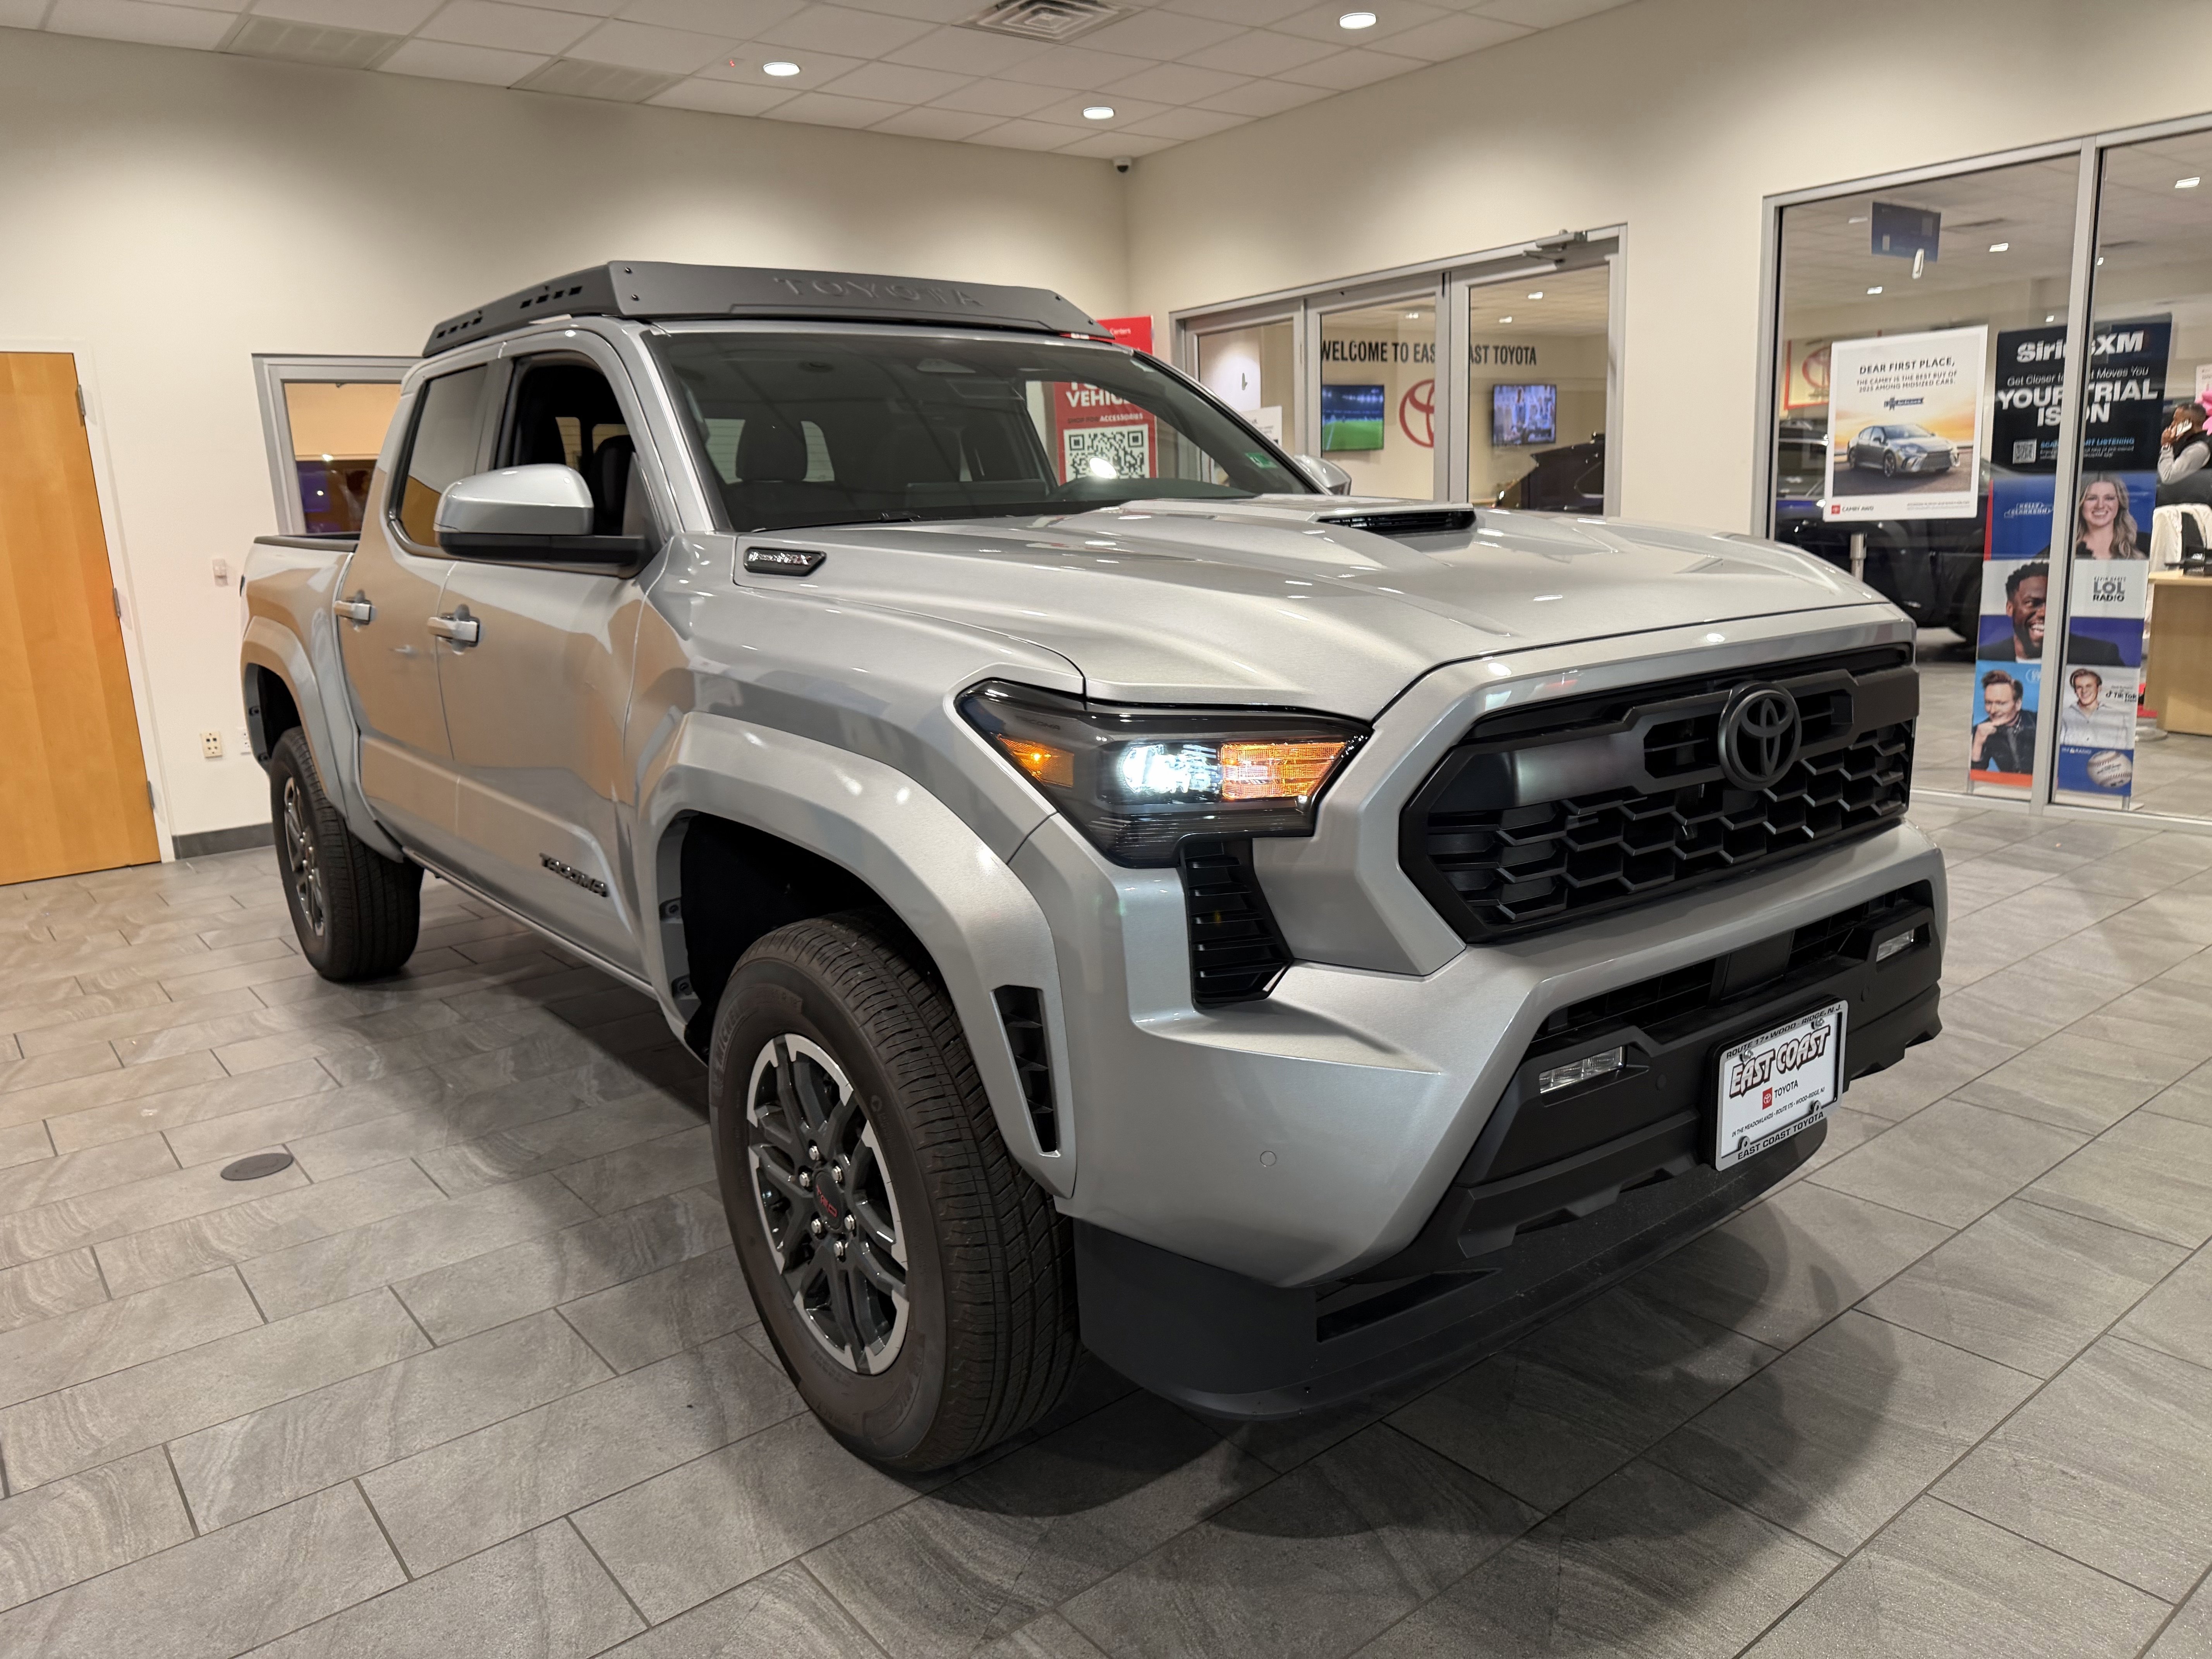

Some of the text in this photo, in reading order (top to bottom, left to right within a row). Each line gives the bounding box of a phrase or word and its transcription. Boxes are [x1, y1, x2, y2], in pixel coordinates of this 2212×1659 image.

[775, 277, 984, 306] TOYOTA
[1322, 340, 1388, 362] WELCOME
[1392, 342, 1408, 363] TO
[1414, 343, 1435, 363] EAS
[1492, 345, 1537, 366] TOYOTA
[2016, 330, 2144, 363] SiriXM
[1860, 356, 1955, 375] DEAR FIRST PLACE,
[1066, 389, 1130, 407] VEHIC
[1099, 412, 1143, 422] ACCESSORIES
[2037, 402, 2110, 427] IS N
[2094, 581, 2125, 594] LOL
[1726, 1043, 1752, 1059] ROUTE
[1755, 1037, 1764, 1045] 17
[1771, 1023, 1796, 1038] WOOD
[1729, 1024, 1831, 1099] EAST COAST
[1774, 1080, 1798, 1098] TOYOTA
[1738, 1111, 1824, 1160] EAST COAST TOYOTA
[816, 1184, 837, 1217] TRD
